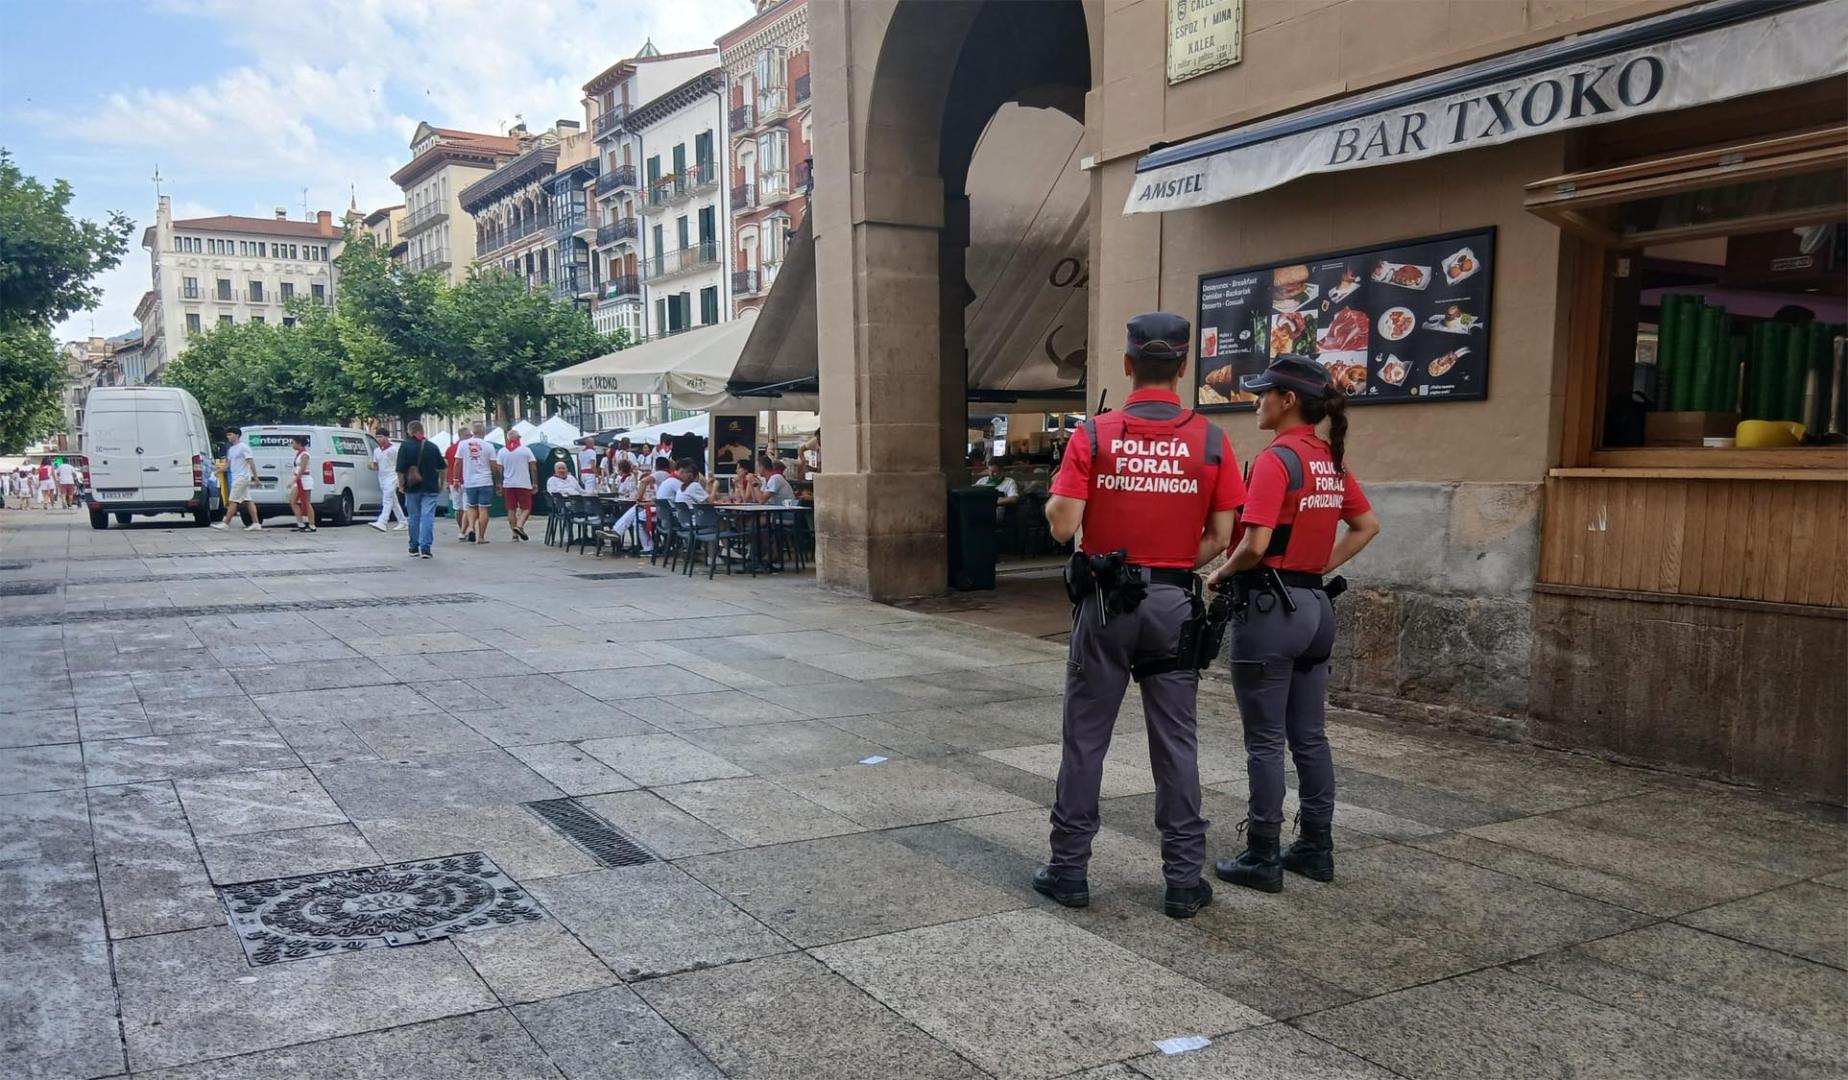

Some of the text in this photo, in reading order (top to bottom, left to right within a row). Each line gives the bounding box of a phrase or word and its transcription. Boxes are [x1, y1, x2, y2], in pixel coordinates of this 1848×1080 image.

[1175, 8, 1232, 39] ESPOZ Y MINA
[1187, 35, 1216, 54] KALEA
[1325, 55, 1665, 166] BAR TXOKO
[1138, 173, 1203, 201] AMSTEL
[594, 376, 618, 390] TXOKO
[1110, 438, 1191, 457] POLICÍA
[1115, 457, 1185, 475] FORAL
[1309, 461, 1346, 475] POLIC
[1096, 474, 1198, 494] FORUZAINGOA
[1315, 476, 1345, 492] FORAL
